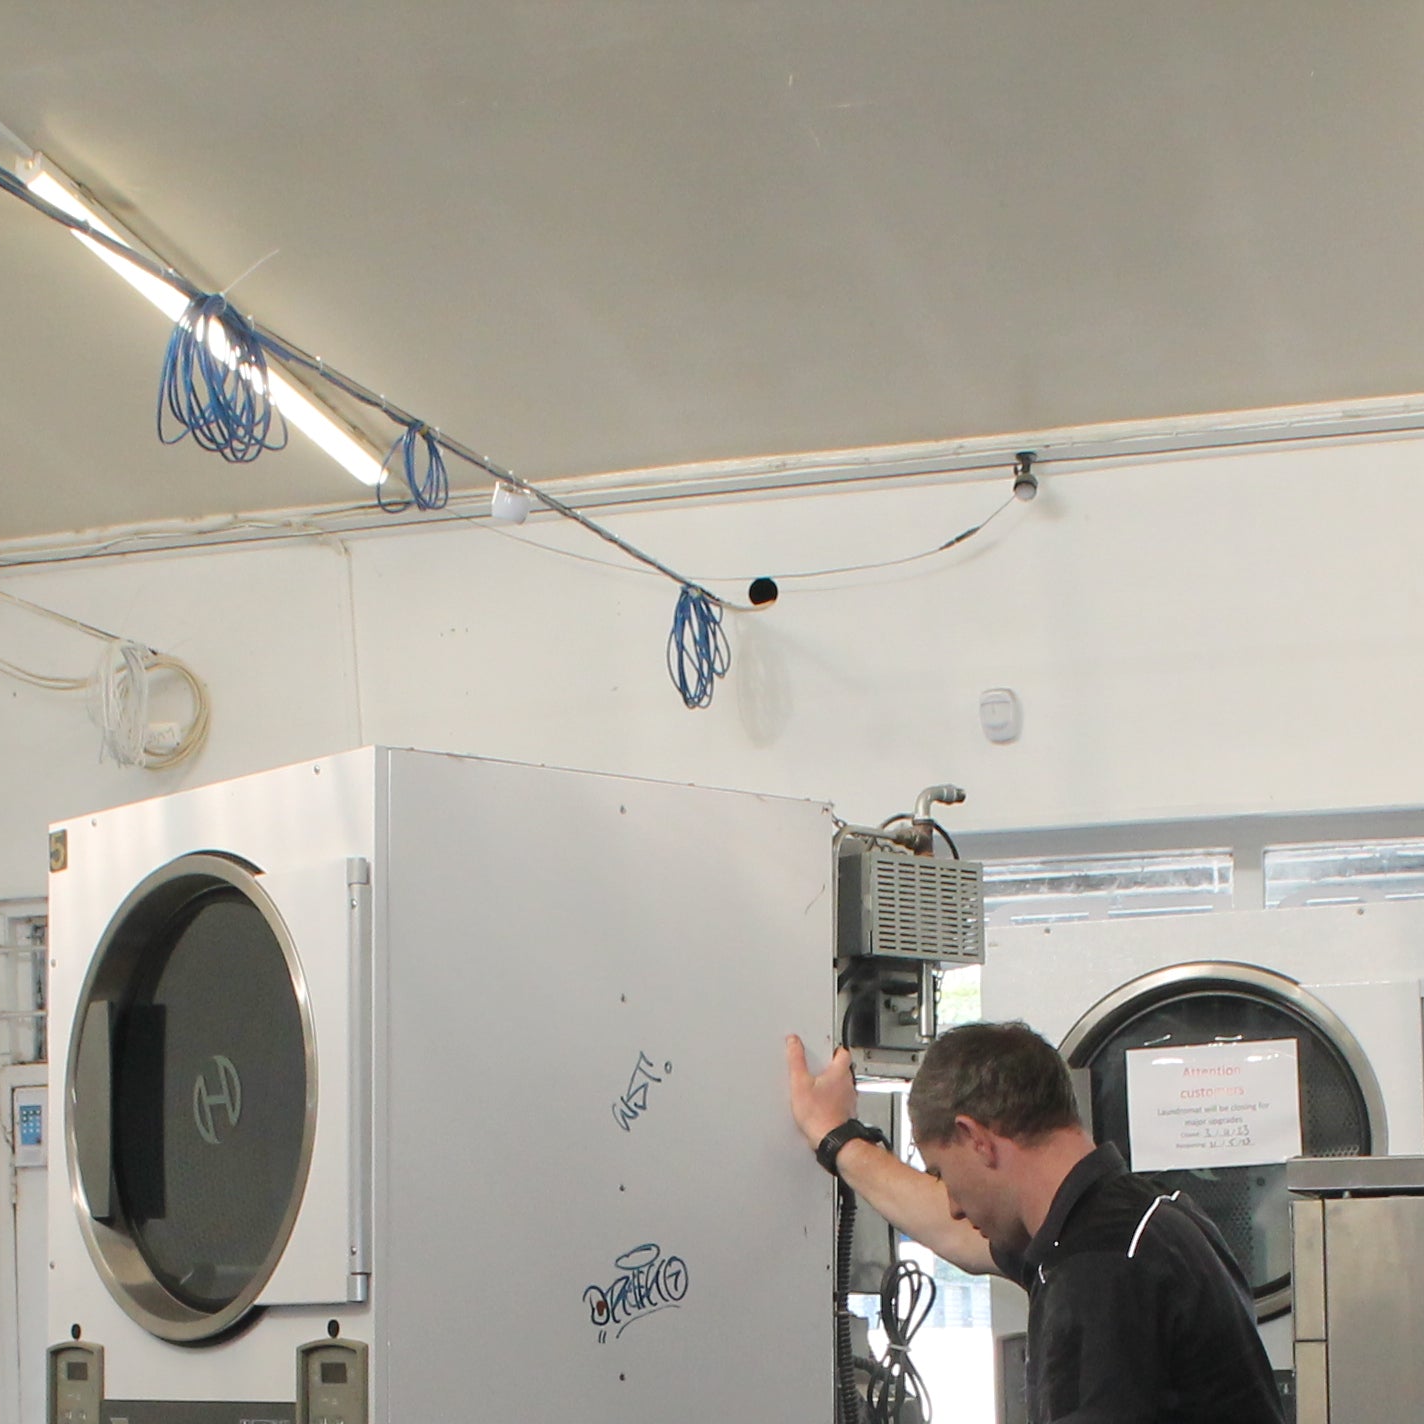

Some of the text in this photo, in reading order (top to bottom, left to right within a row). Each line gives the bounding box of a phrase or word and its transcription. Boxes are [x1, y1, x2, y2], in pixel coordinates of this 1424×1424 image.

[50, 832, 65, 869] 5
[1183, 1065, 1241, 1077] Attention
[1180, 1084, 1245, 1099] customers
[1219, 1103, 1229, 1112] be
[1258, 1101, 1269, 1110] for
